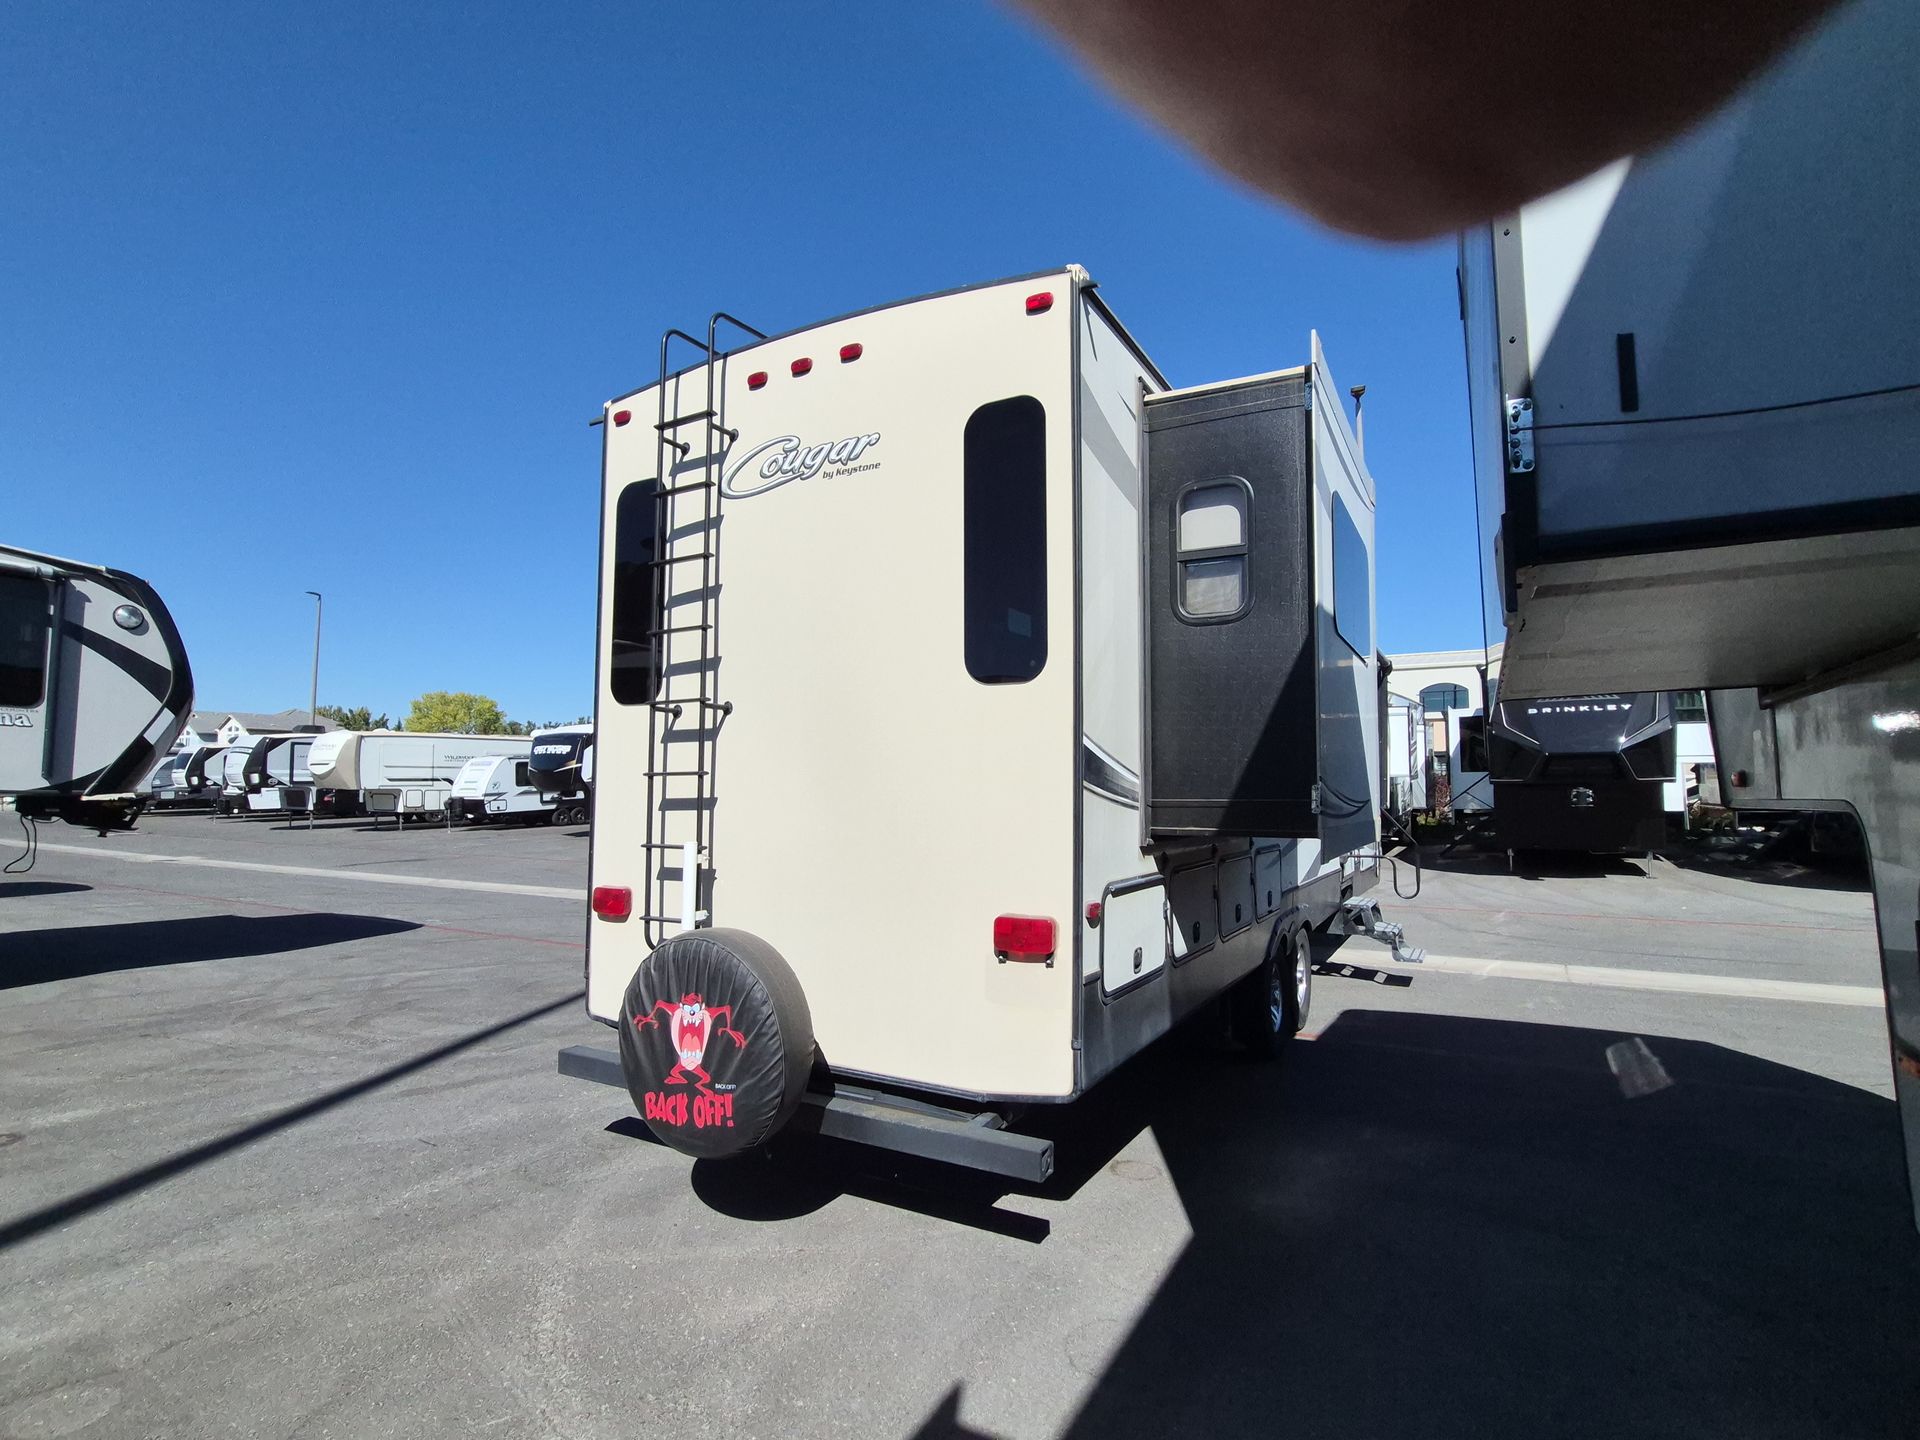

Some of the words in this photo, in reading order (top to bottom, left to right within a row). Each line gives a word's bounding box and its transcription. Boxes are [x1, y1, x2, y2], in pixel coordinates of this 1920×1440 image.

[721, 432, 881, 500] Cougar
[822, 470, 834, 480] by
[835, 462, 881, 477] Keystone
[1527, 703, 1632, 714] BRINKLEY
[644, 1091, 688, 1127] BACK
[693, 1093, 735, 1129] OFF!
